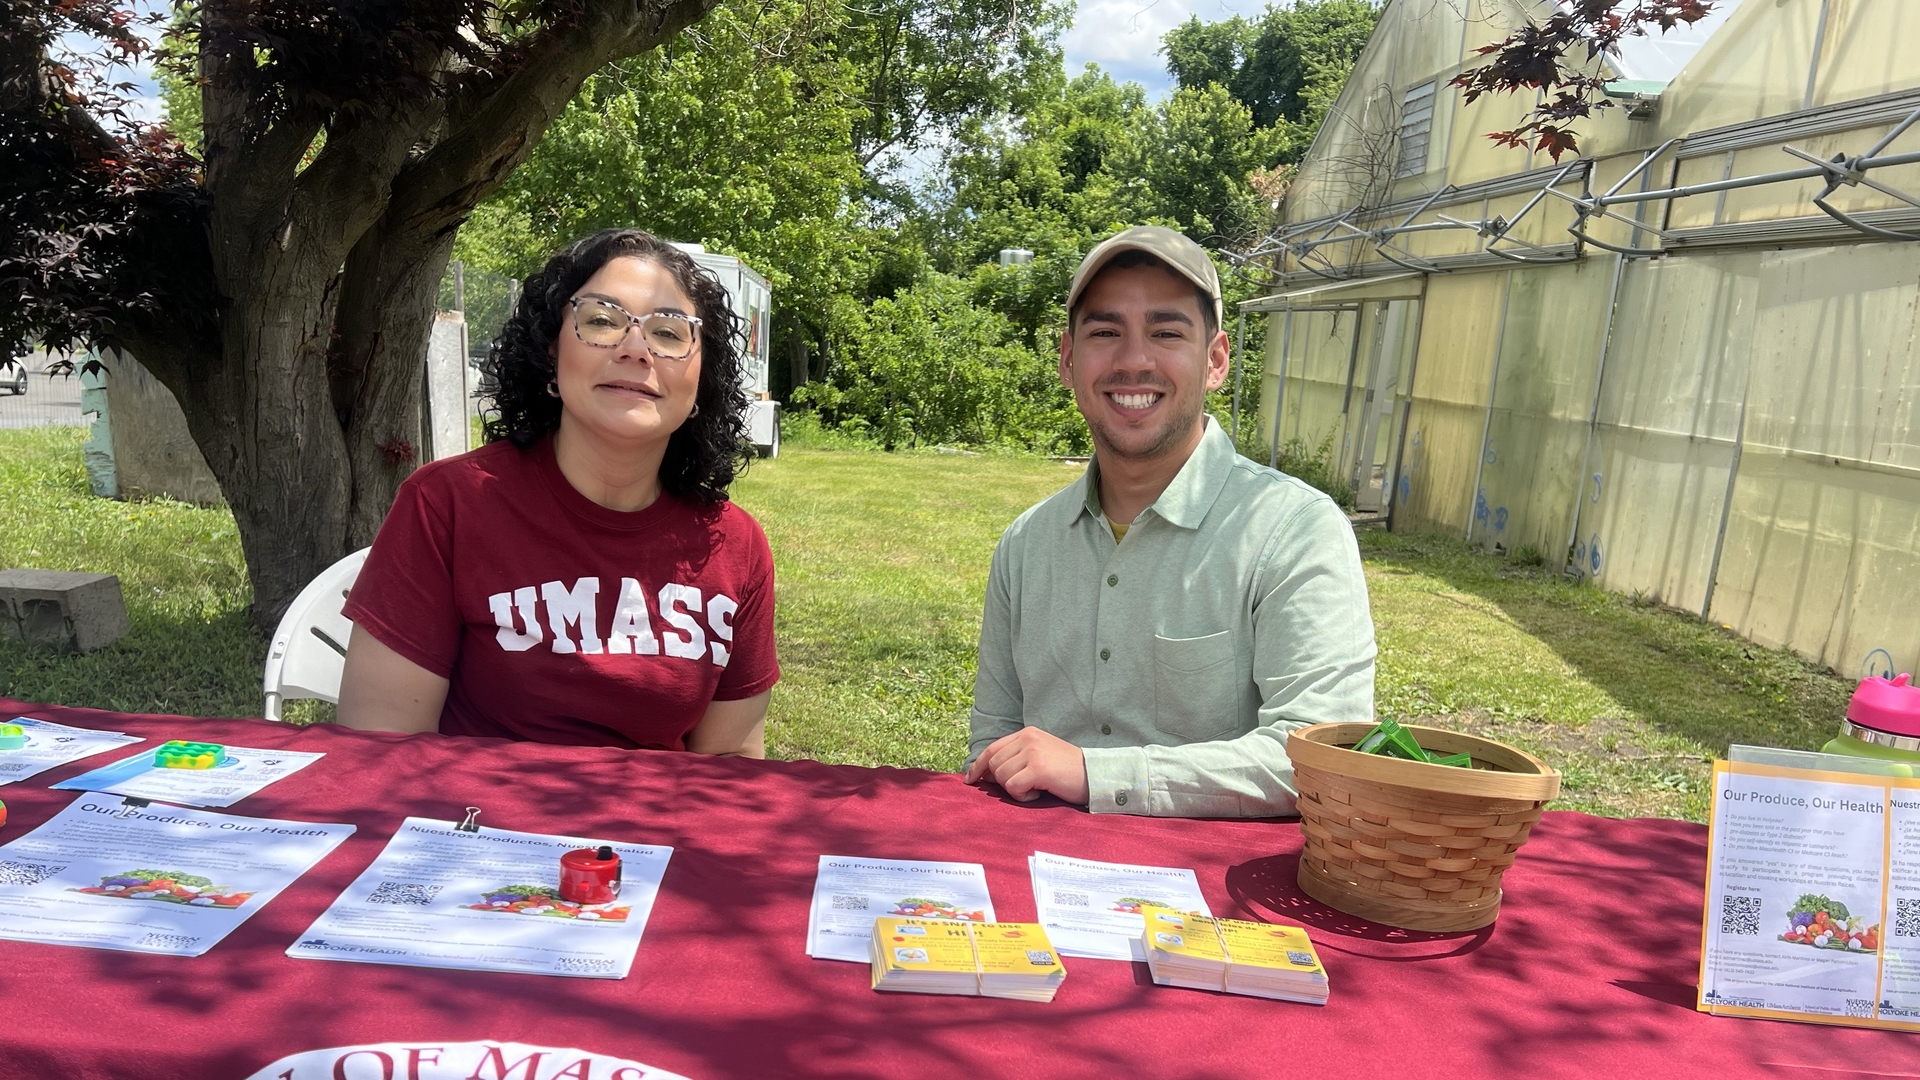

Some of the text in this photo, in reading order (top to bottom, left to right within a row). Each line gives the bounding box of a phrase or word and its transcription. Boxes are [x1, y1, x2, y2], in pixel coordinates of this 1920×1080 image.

[488, 576, 739, 668] UMASS
[1723, 788, 1883, 814] Our Produce, Our Health
[80, 803, 328, 837] Our Produce, Our Health
[410, 826, 473, 839] Nuestros
[477, 834, 552, 848] Productos,
[614, 847, 654, 855] Salud
[1729, 829, 1760, 837] pre-diabetes
[1766, 831, 1778, 839] Type
[1783, 833, 1806, 841] diabetes?
[1746, 838, 1774, 846] self-identify
[1781, 840, 1802, 848] Hispanic
[854, 863, 907, 873] Produce,
[910, 866, 932, 874] Our
[935, 868, 975, 877] Health
[1045, 858, 1066, 866] Our
[1068, 860, 1121, 873] Produce,
[1146, 869, 1186, 878] Health
[1778, 876, 1806, 884] workshops
[1814, 879, 1837, 887] Nuestras
[297, 943, 408, 955] HOLYOKE HEALTH
[1705, 997, 1737, 1007] HOLYOKE
[1739, 1001, 1765, 1009] HEALTH
[1845, 998, 1875, 1008] NUESTRAS
[1877, 1008, 1909, 1017] HOLYOKE
